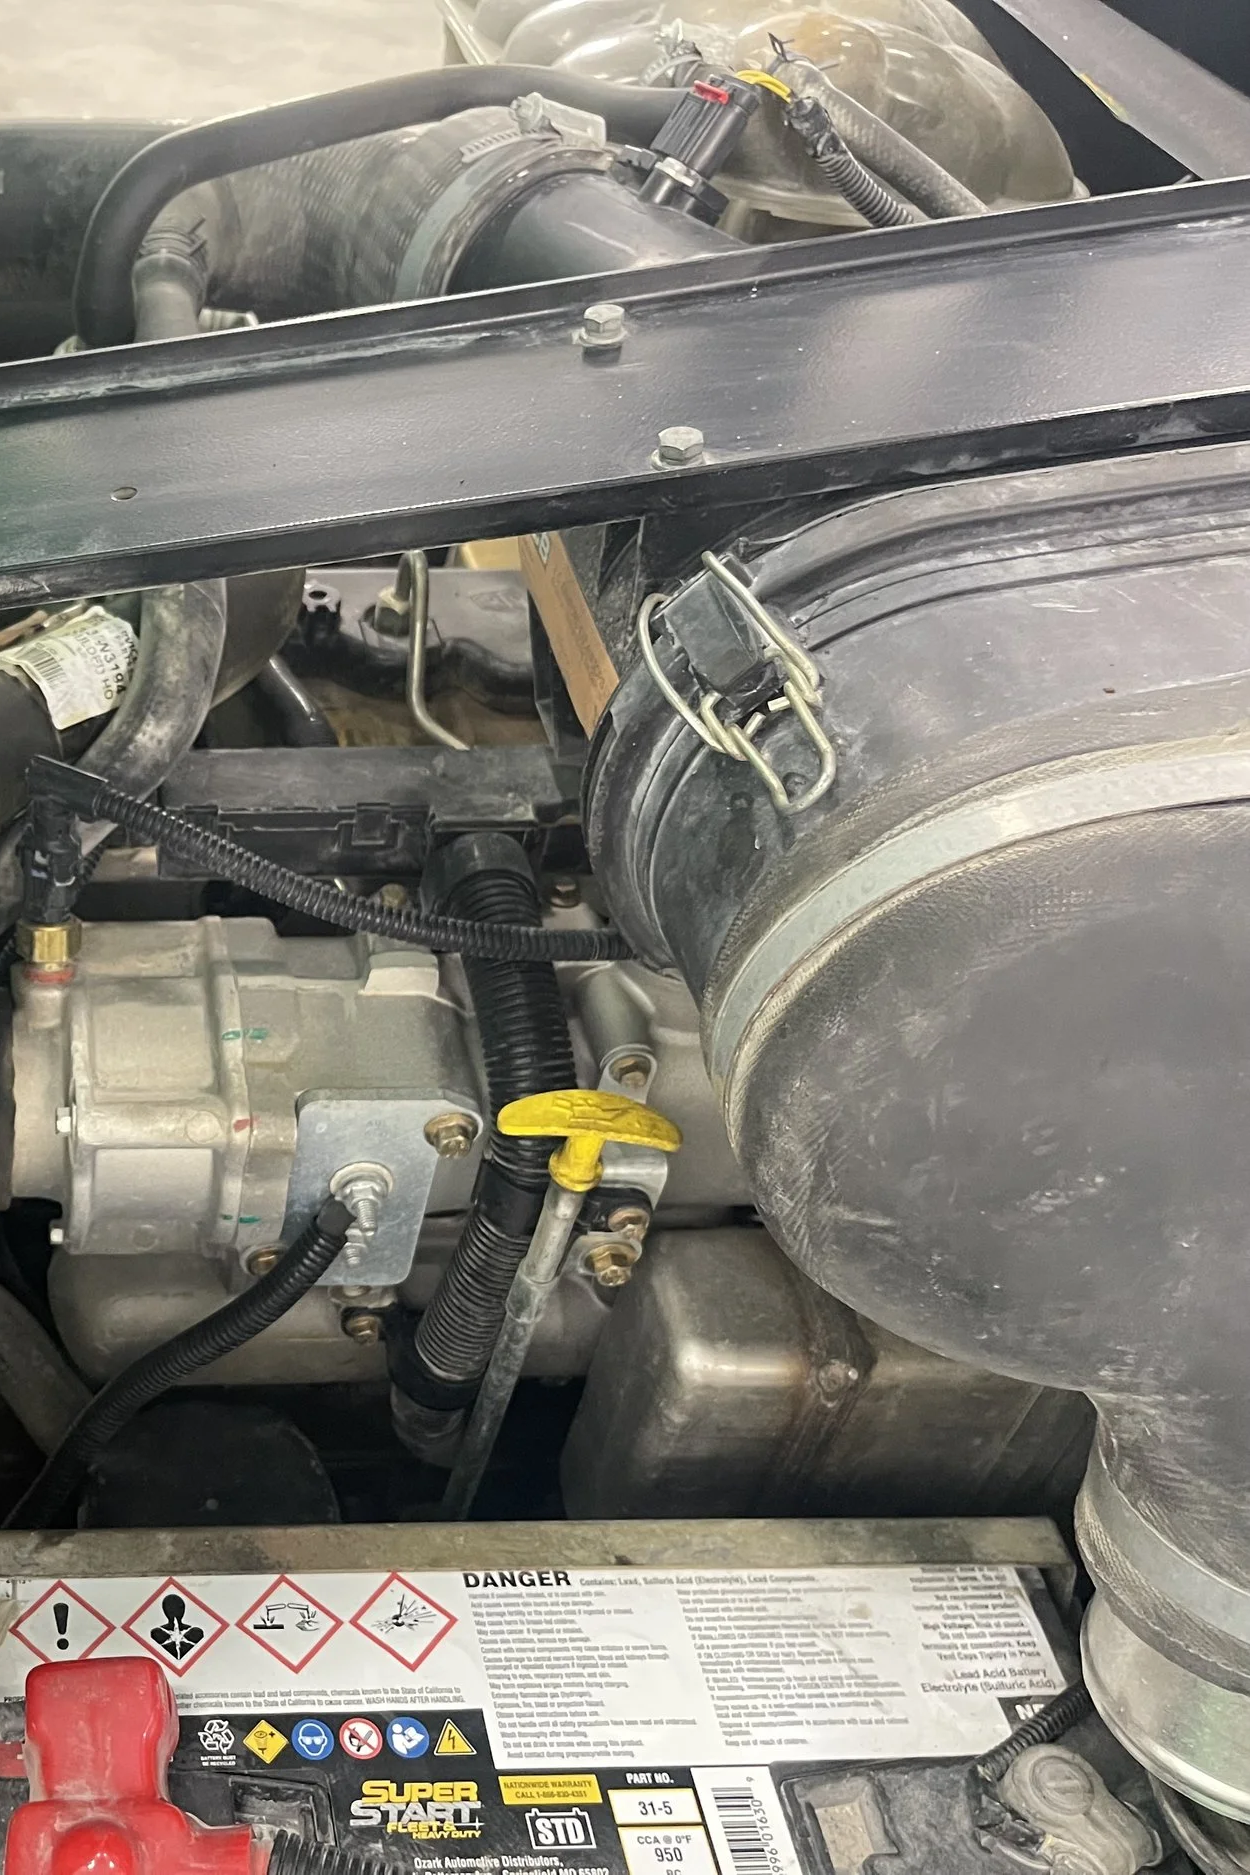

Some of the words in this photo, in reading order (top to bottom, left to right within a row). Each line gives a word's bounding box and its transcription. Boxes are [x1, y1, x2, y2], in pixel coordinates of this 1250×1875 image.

[462, 1570, 572, 1588] DANGER
[952, 1670, 980, 1680] Lead
[983, 1668, 1007, 1678] Acid
[1008, 1667, 1047, 1678] Battery
[920, 1682, 979, 1694] Electrolyte
[1028, 1679, 1056, 1691] Acid)
[504, 1781, 549, 1789] NATIONWIDE
[550, 1780, 592, 1788] WARRANTY
[626, 1772, 654, 1785] PART
[655, 1772, 675, 1784] NO.
[361, 1780, 478, 1803] SUPER
[515, 1791, 535, 1799] CALL
[350, 1800, 482, 1826] START
[638, 1800, 674, 1816] 31-5
[387, 1822, 440, 1833] FLEET
[442, 1821, 456, 1832] &
[751, 1799, 774, 1842] 01630
[412, 1830, 450, 1839] HEAVY
[451, 1829, 482, 1839] DUTY
[535, 1817, 586, 1846] STD
[637, 1835, 661, 1845] CCA
[414, 1856, 443, 1869] Ozark
[444, 1855, 499, 1869] Automotive
[501, 1854, 565, 1869] Distributors,
[654, 1846, 683, 1862] 950
[768, 1847, 784, 1875] 996
